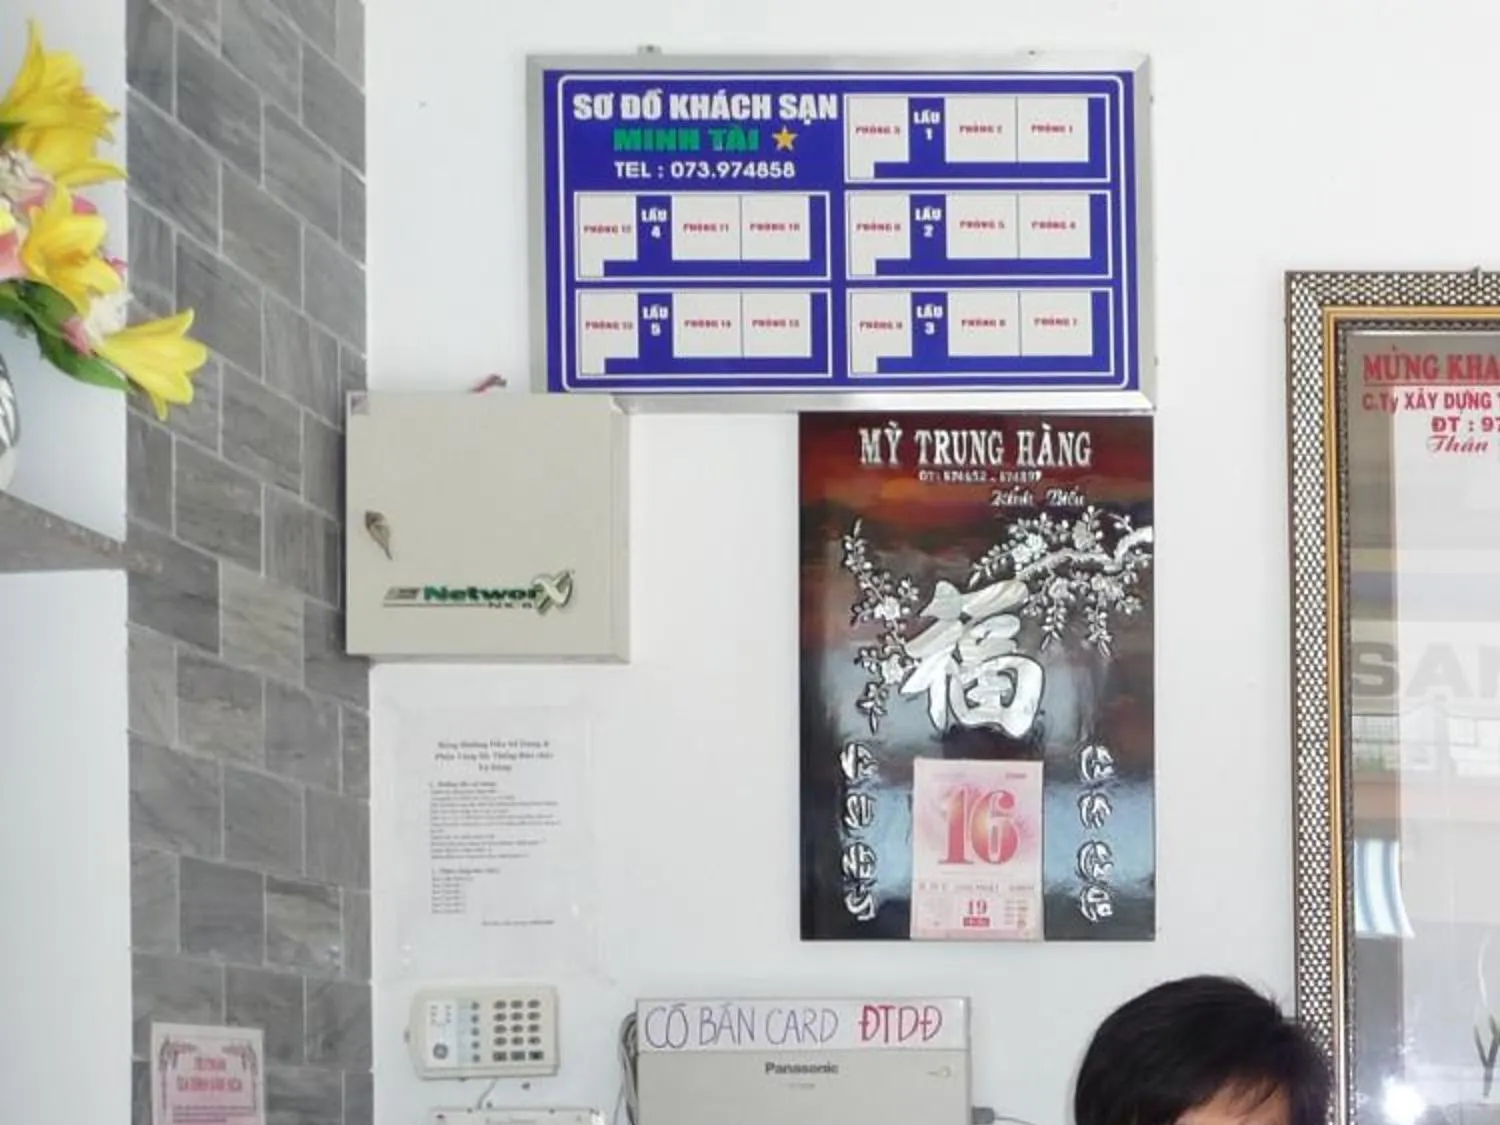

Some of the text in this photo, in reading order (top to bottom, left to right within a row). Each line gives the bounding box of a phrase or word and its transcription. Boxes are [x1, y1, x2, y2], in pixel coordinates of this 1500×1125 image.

[572, 91, 615, 120] SƠ
[669, 88, 772, 120] KHÁCH
[778, 92, 838, 125] SẠN
[612, 123, 760, 152] MINH TÀI
[925, 127, 933, 141] 1
[614, 161, 651, 179] TEL
[670, 161, 796, 179] 073.974858
[651, 226, 661, 239] 4
[923, 225, 934, 238] 2
[651, 323, 661, 336] 5
[925, 322, 935, 335] 3
[914, 429, 1005, 467] TRUNG
[900, 580, 1046, 737] 福
[938, 787, 1019, 866] 16
[967, 899, 988, 915] 19
[644, 1002, 690, 1049] CÓ
[765, 1006, 840, 1045] CARD
[765, 1061, 840, 1076] Panasonic
